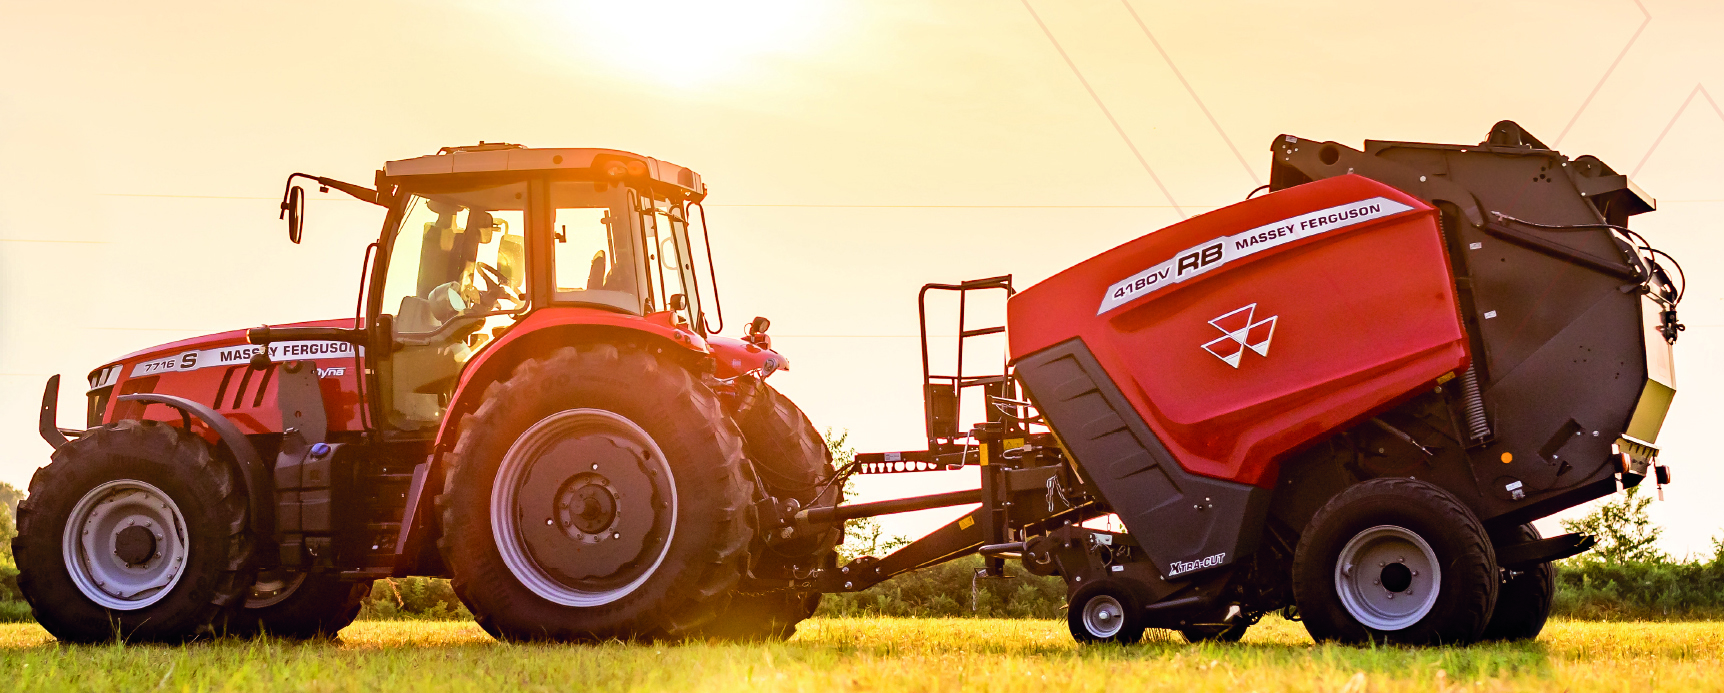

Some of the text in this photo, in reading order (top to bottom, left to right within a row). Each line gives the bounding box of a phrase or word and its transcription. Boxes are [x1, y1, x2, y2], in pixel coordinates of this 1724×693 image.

[1113, 204, 1381, 298] 4180V RB MASSEY FERGUSON
[144, 360, 175, 372] 7716
[180, 352, 198, 369] S
[220, 345, 278, 362] MASSY
